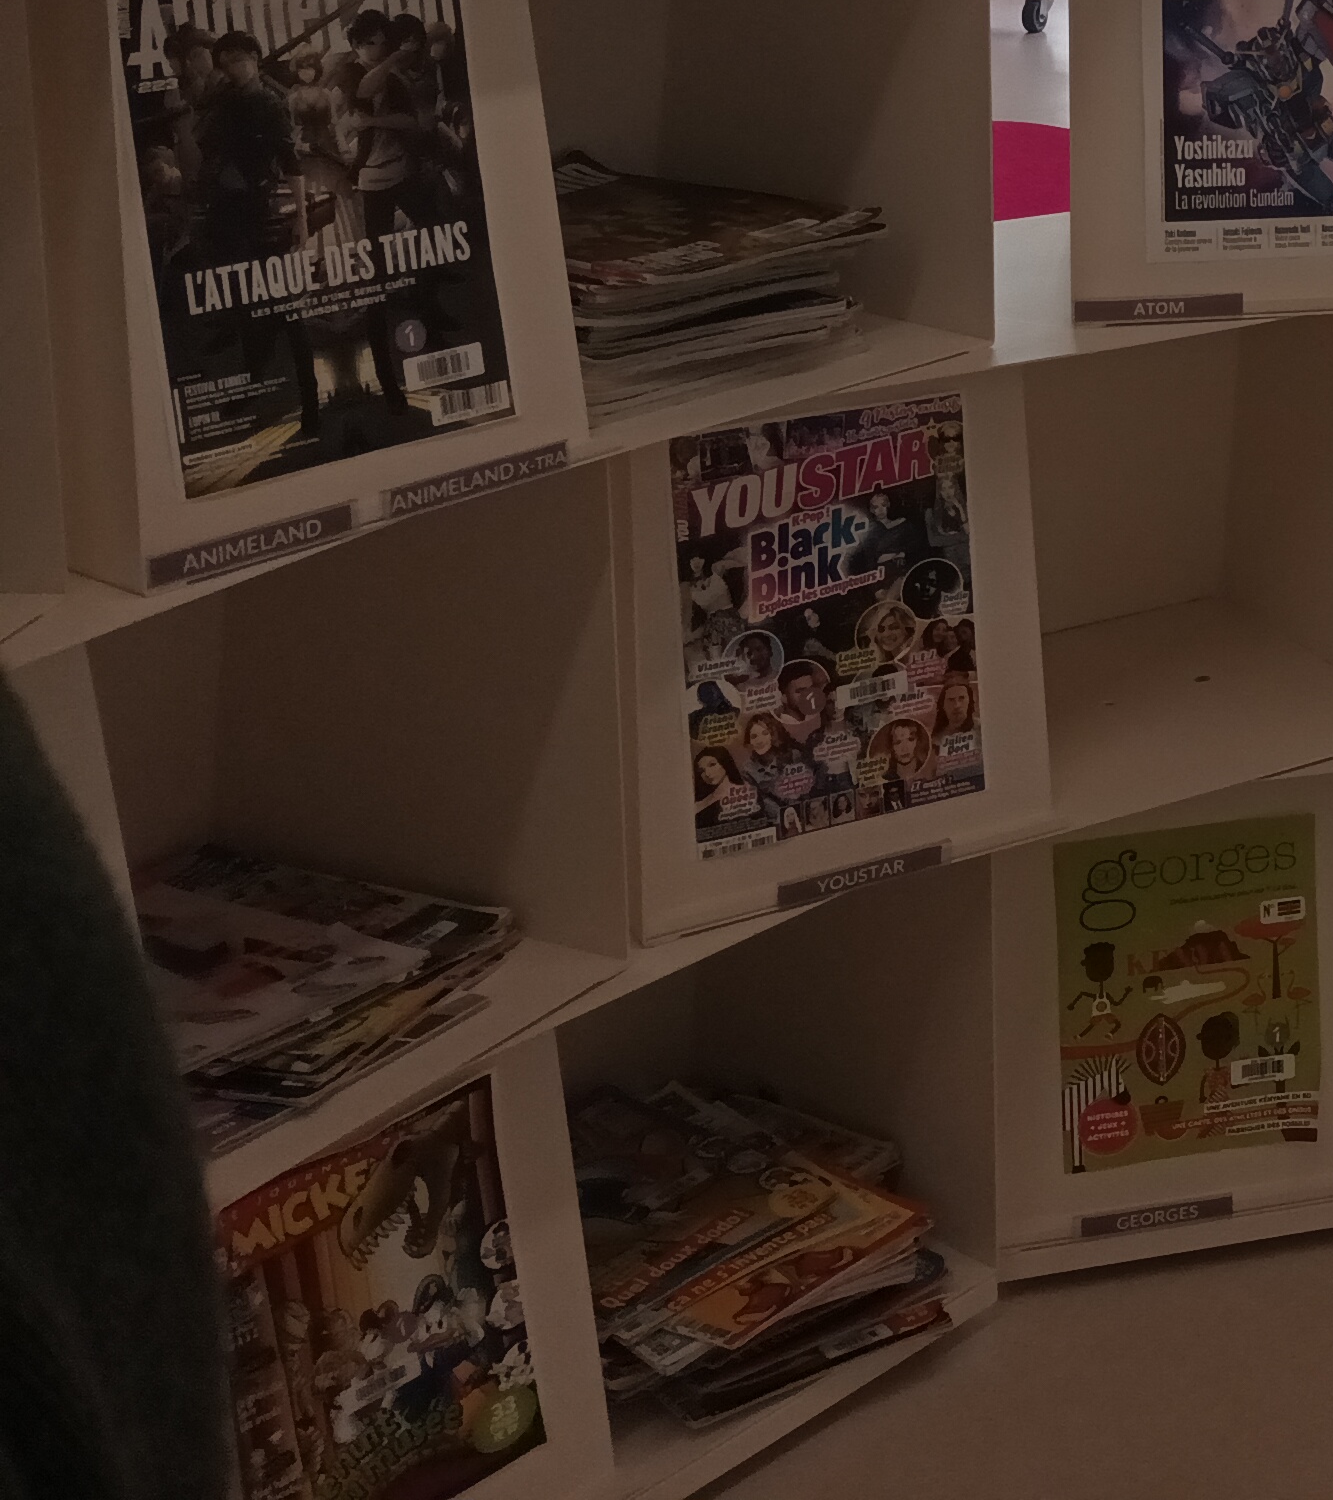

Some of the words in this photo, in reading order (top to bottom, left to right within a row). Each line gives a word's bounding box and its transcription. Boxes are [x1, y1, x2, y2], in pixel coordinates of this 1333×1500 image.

[1174, 135, 1255, 161] Yoshikazu
[1174, 164, 1246, 188] Yasuhiko
[1175, 191, 1189, 210] La
[1191, 189, 1247, 210] révolution
[1249, 189, 1295, 208] Gundam
[184, 249, 323, 316] L'ATTAQUE
[323, 237, 375, 288] DES
[378, 220, 472, 276] TITANS
[251, 308, 271, 318] LES
[286, 312, 299, 322] LA
[1133, 301, 1185, 316] ATOM
[404, 325, 415, 347] 1
[390, 461, 515, 512] ANIMELAND
[518, 446, 568, 479] X-TRA
[691, 429, 934, 538] YOUSTAR
[182, 518, 323, 575] ANIMELAND
[751, 507, 867, 572] Black-
[751, 545, 842, 602] pink
[801, 589, 818, 602] les
[819, 572, 877, 597] compteurs
[817, 859, 905, 893] YOUSTAR
[1079, 841, 1297, 932] georges
[231, 1158, 380, 1257] MICKE
[1116, 1205, 1199, 1230] GEORGES
[600, 1278, 649, 1308] Quel
[649, 1245, 698, 1278] doux
[691, 1278, 718, 1296] ne
[717, 1231, 796, 1278] s'invente
